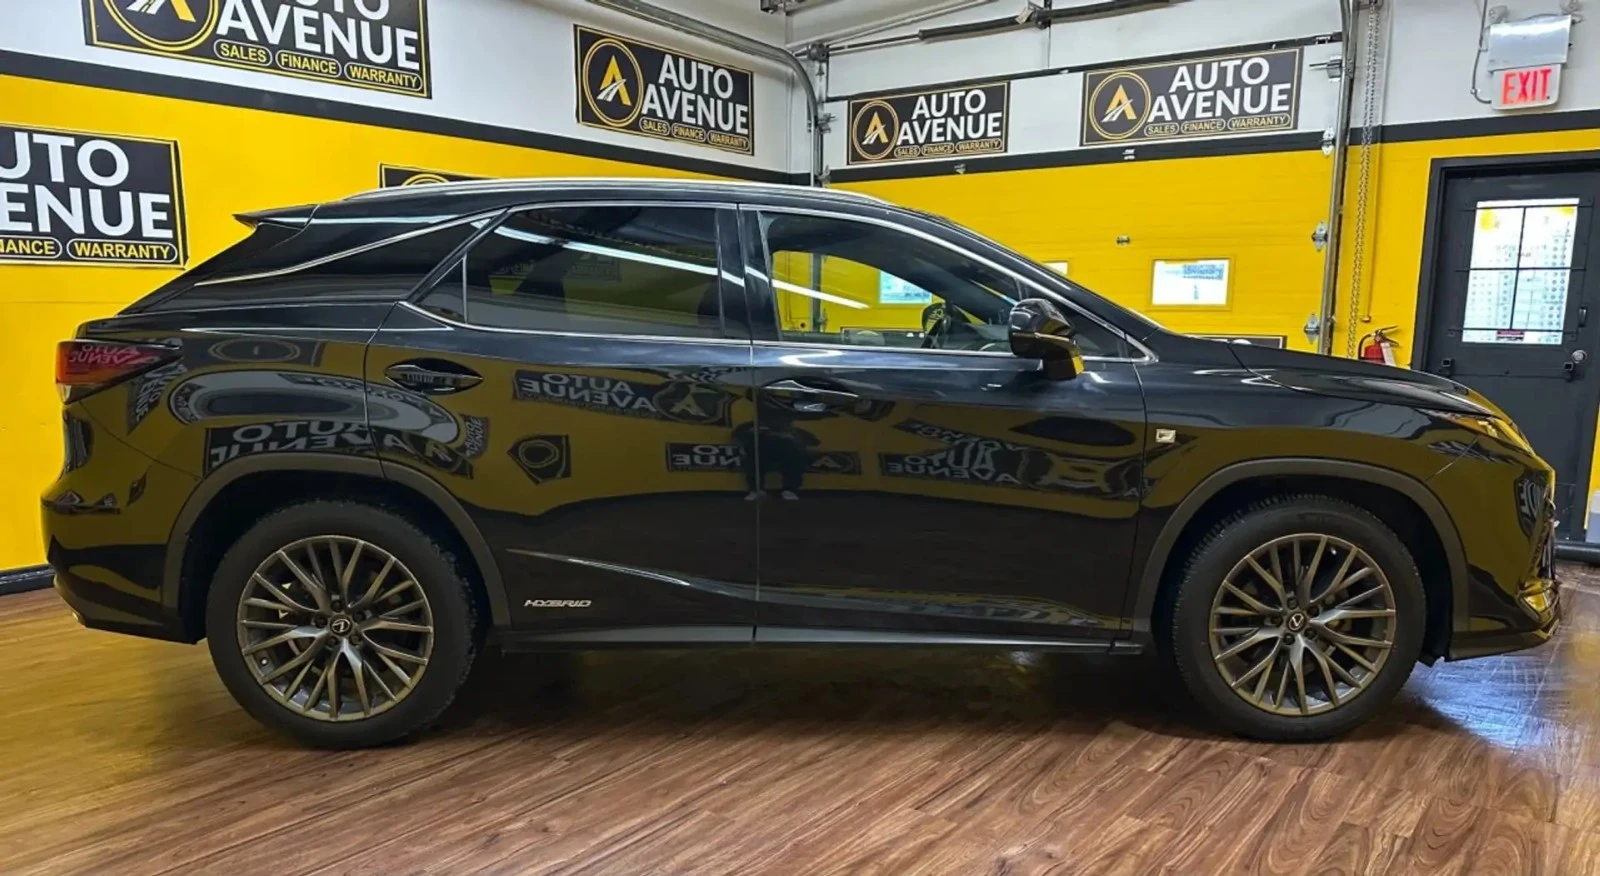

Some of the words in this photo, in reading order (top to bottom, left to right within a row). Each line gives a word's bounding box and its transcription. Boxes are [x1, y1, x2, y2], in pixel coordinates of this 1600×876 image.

[216, 0, 420, 70] AVENUE
[220, 43, 267, 63] SALES
[280, 53, 337, 74] FINANCE
[350, 65, 417, 88] WARRANTY
[658, 54, 734, 99] AUTO
[1168, 57, 1270, 93] AUTO
[1147, 83, 1291, 123] AVENUE
[1502, 68, 1552, 105] EXIT
[641, 83, 748, 135] AVENUE
[911, 89, 986, 120] AUTO
[642, 119, 668, 134] SALES
[673, 125, 704, 140] FINANCE
[710, 132, 748, 148] WARRANTY
[896, 112, 1003, 146] AVENUE
[1147, 125, 1177, 135] SALES
[1183, 121, 1222, 132] FINANCE
[1231, 116, 1286, 128] WARRANTY
[897, 146, 918, 156] SALES
[923, 144, 953, 154] FINANCE
[958, 140, 999, 151] WARRANTY
[74, 241, 170, 259] WARRANTY
[523, 599, 592, 608] HYBRID
